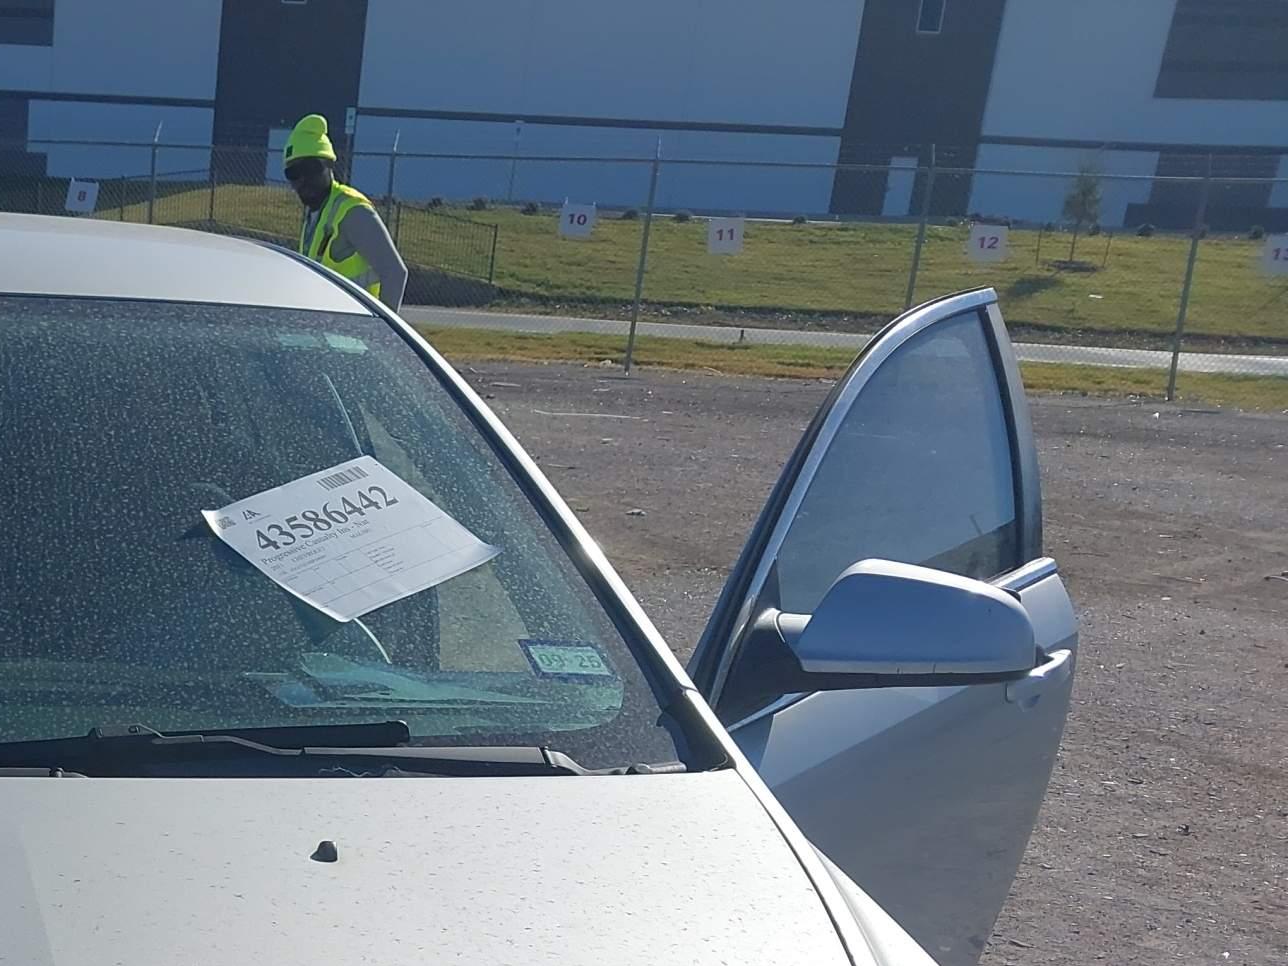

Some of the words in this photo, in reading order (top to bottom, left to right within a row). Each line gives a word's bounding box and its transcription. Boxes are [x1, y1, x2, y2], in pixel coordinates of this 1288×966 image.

[568, 213, 587, 226] 10
[716, 228, 734, 241] 11
[978, 236, 999, 249] 12
[256, 485, 399, 551] 43586442
[261, 542, 306, 565] Progressive
